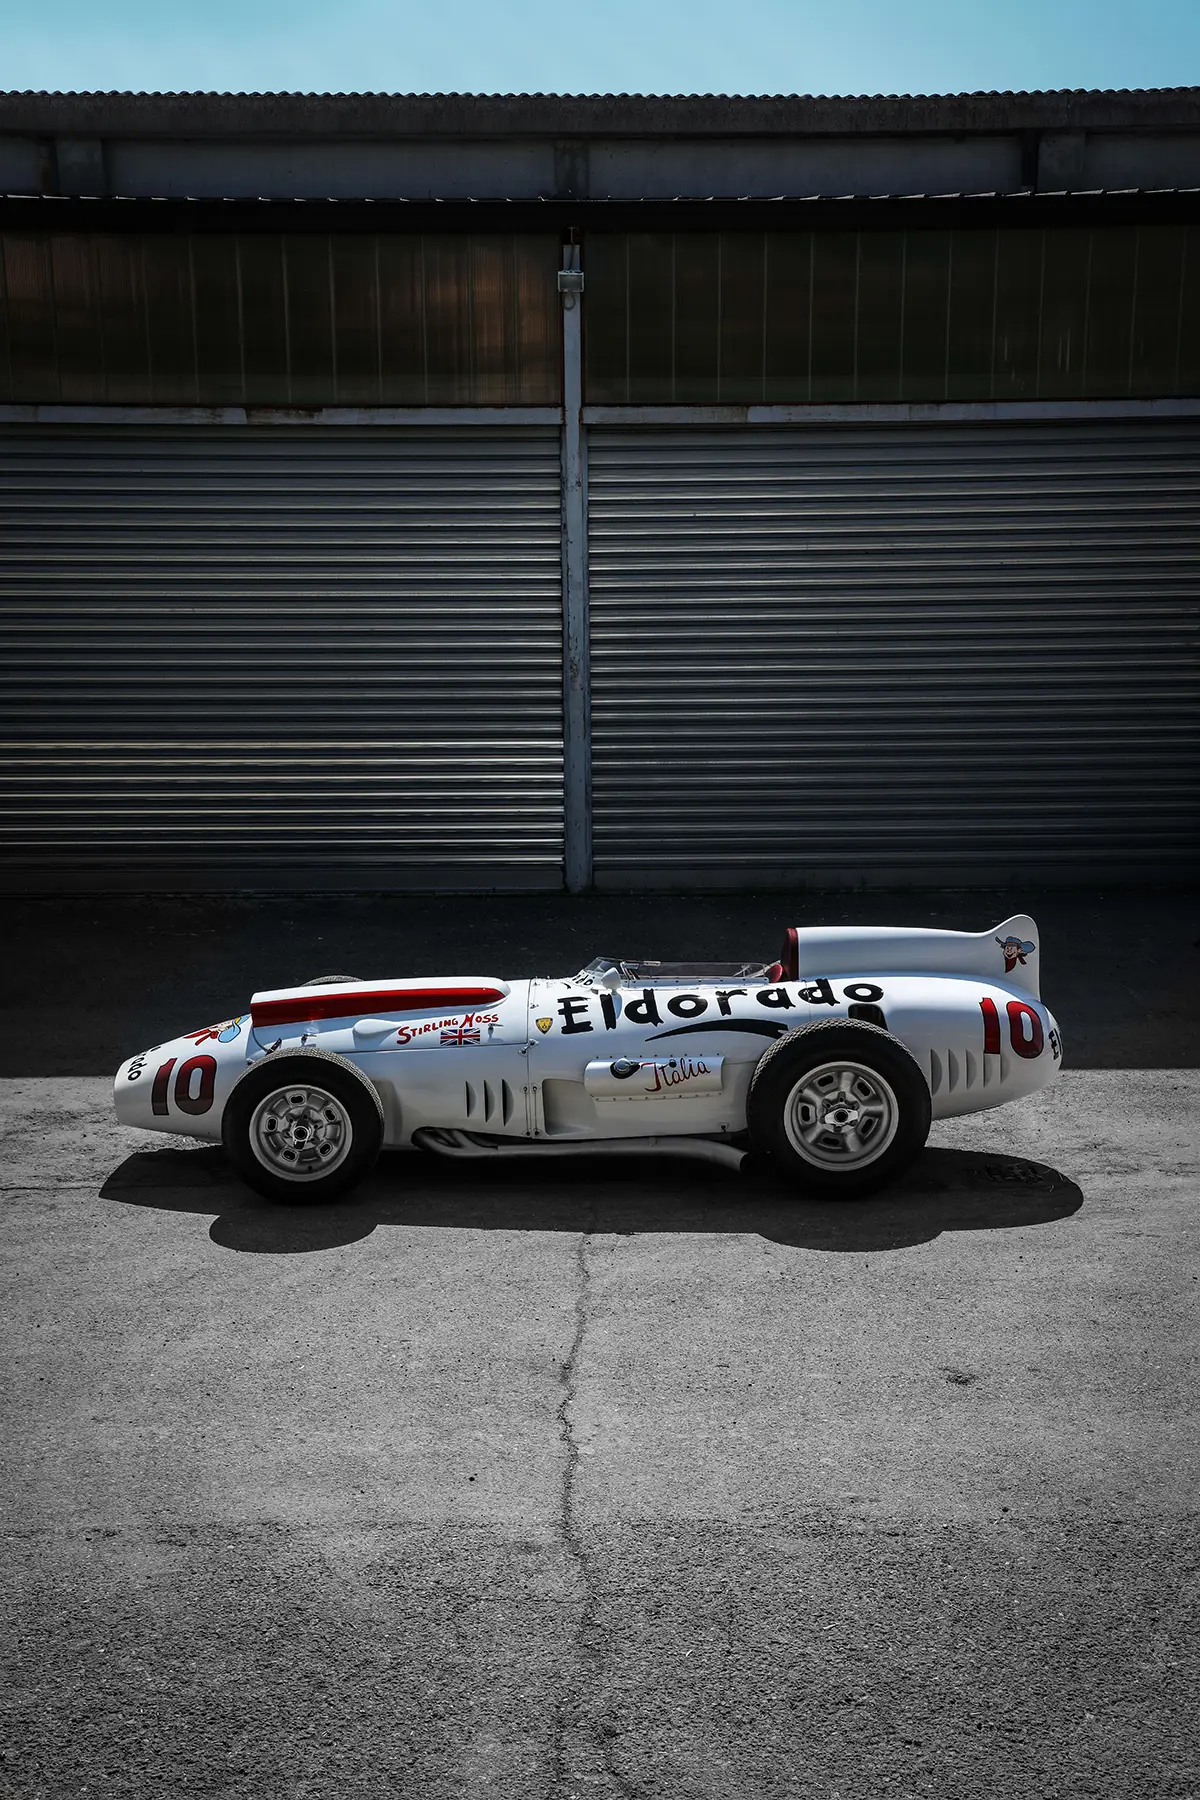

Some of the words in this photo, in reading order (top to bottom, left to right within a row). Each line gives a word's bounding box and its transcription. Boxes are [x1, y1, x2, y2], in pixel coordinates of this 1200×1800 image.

[396, 1018, 459, 1045] STIRLING
[459, 1012, 499, 1029] MOSS
[557, 977, 885, 1035] Eldorado
[979, 997, 1044, 1059] 10
[151, 1054, 218, 1116] 10
[640, 1057, 711, 1092] Italia
